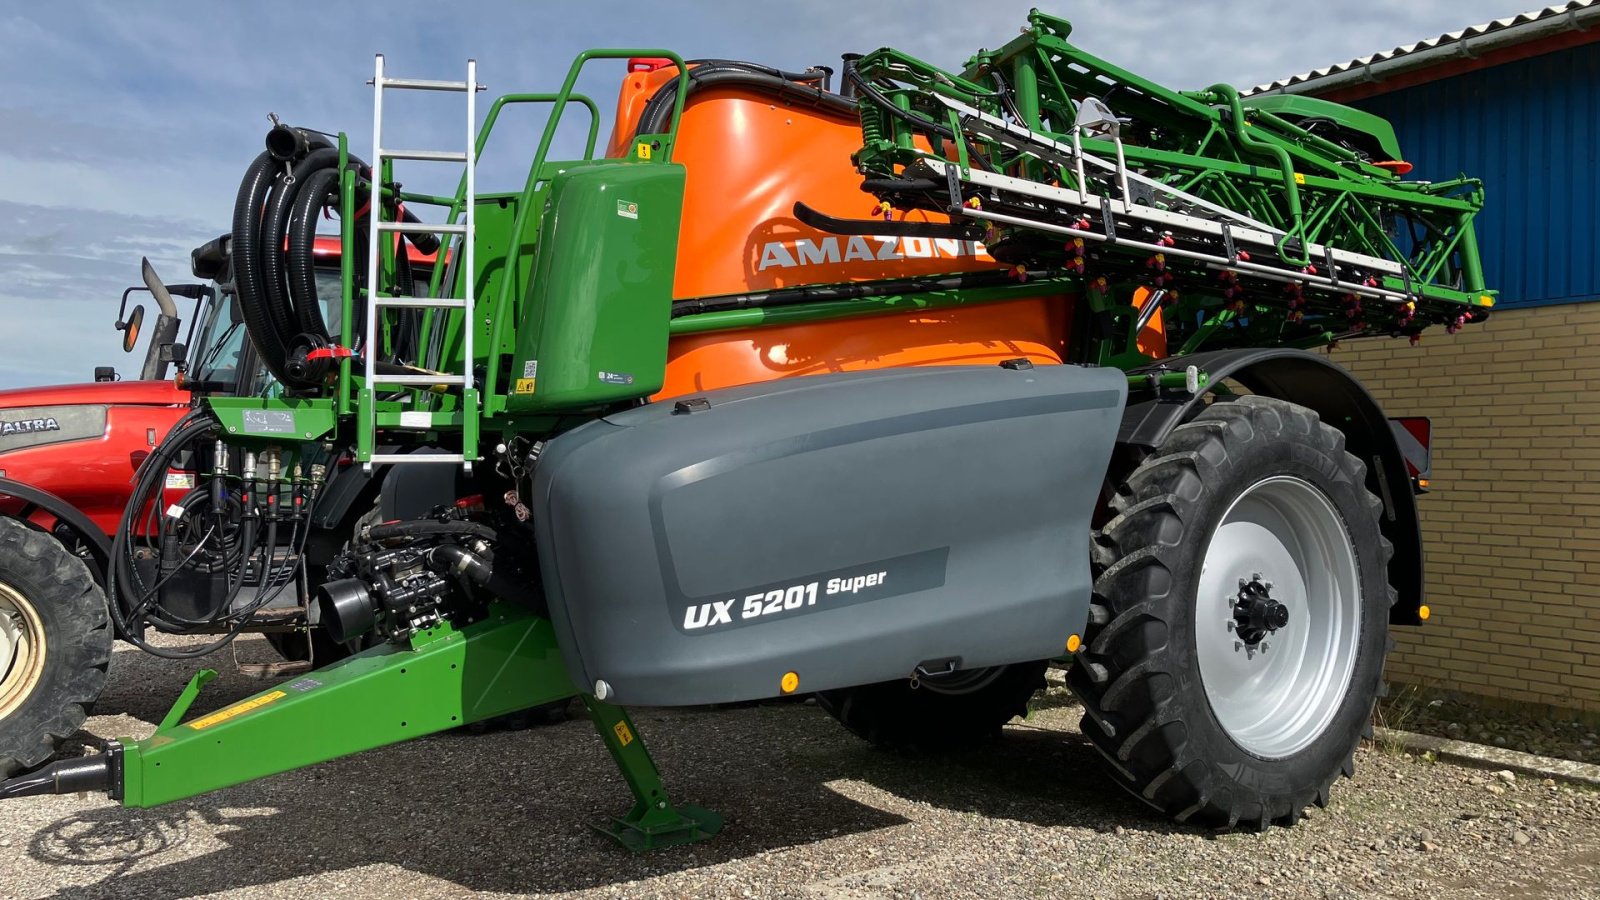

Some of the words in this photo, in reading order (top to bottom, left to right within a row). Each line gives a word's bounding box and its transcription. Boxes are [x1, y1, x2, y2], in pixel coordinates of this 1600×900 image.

[758, 235, 987, 271] AMAZONE
[0, 418, 60, 436] ALTRA
[684, 599, 735, 629] UX
[742, 582, 819, 620] 5201
[826, 571, 887, 595] Super
